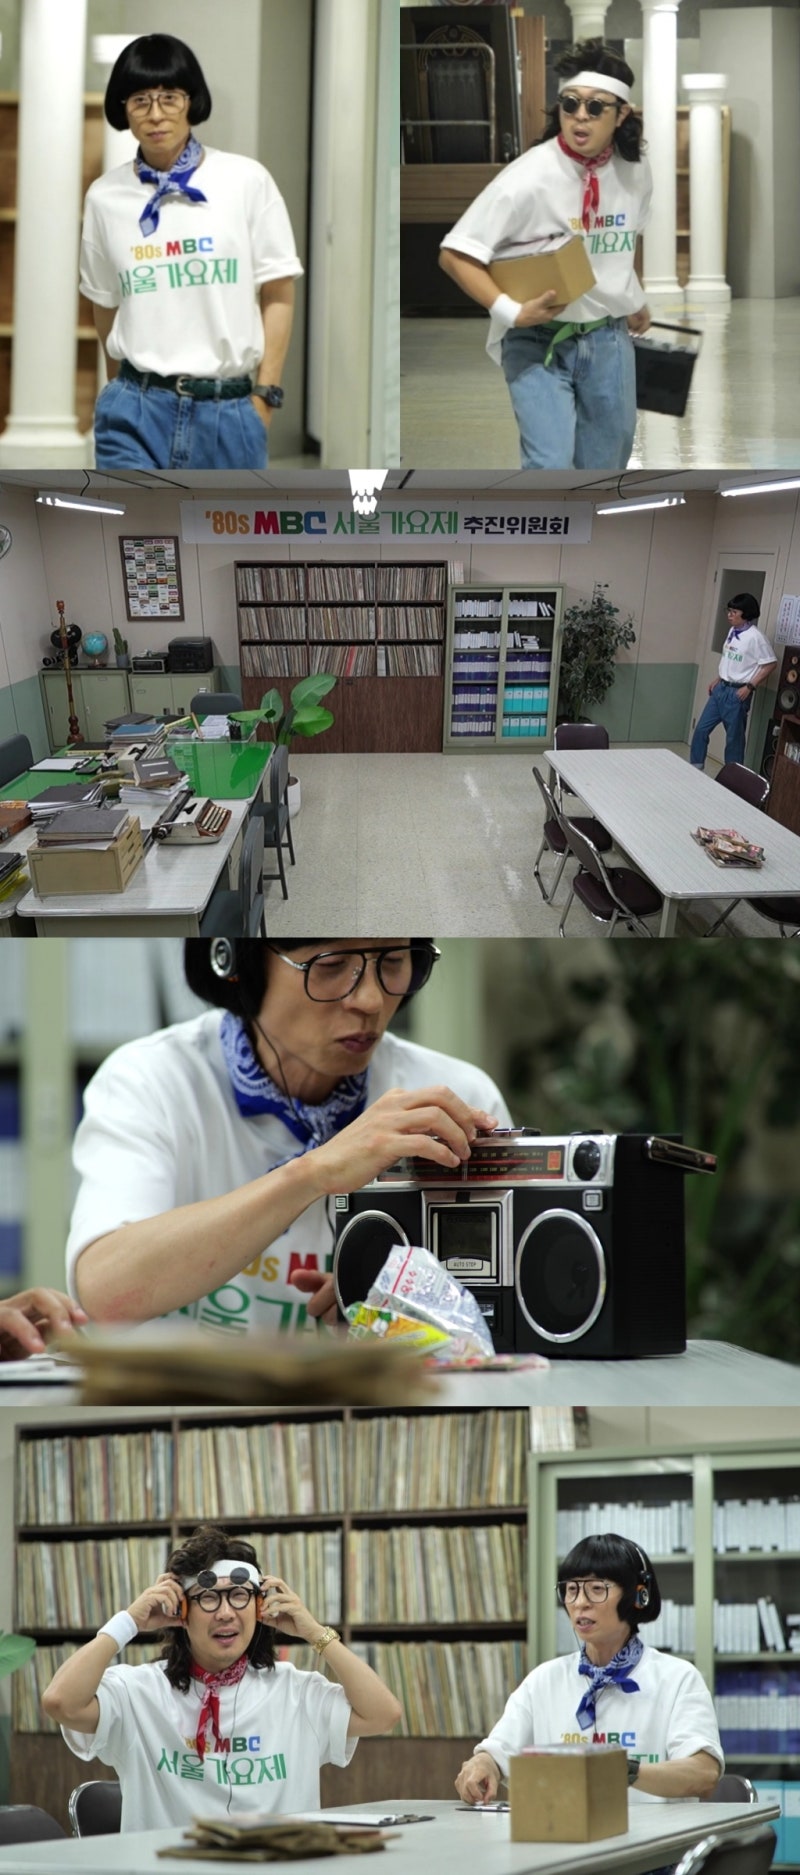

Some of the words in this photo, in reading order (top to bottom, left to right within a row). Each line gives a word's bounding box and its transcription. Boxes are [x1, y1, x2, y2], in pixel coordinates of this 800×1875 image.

[594, 213, 625, 229] MBC
[130, 244, 163, 261] '80s
[166, 237, 214, 257] MBC
[118, 258, 238, 298] 서울가요제
[205, 510, 249, 535] '80s
[254, 511, 327, 535] MBC
[333, 510, 458, 535] 서울가요제
[463, 516, 570, 535] 추진위원회
[214, 1736, 261, 1754] MBC
[592, 1732, 636, 1748] MBC
[157, 1748, 288, 1786] 서울가요제
